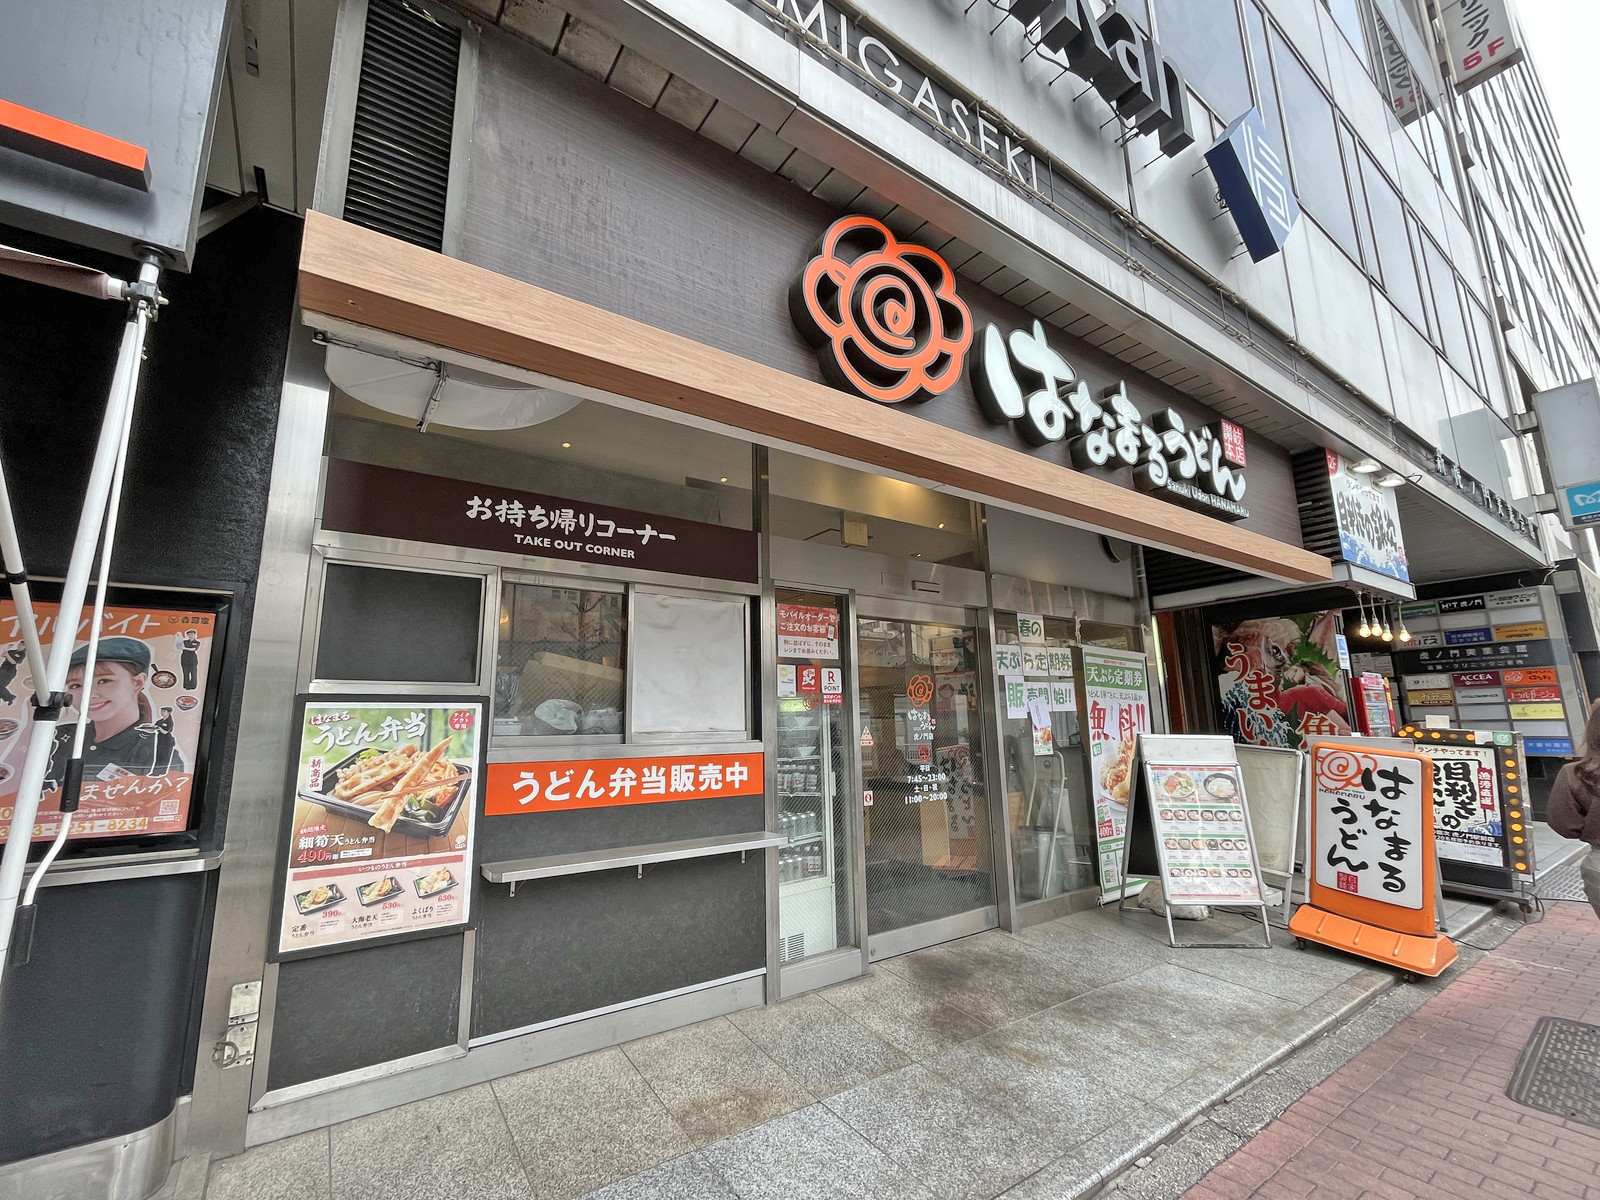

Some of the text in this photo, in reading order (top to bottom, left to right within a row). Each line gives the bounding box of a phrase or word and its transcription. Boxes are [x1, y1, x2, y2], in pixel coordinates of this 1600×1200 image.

[983, 318, 1247, 502] はなまるうどん
[1167, 478, 1249, 518] Sanuki Udon HANAMARU
[465, 495, 676, 545] お持ち帰りコーナー
[514, 533, 635, 559] TAKE OUT CORNER
[780, 622, 827, 634] ご注文のお客様
[1019, 619, 1042, 637] 春の
[1420, 644, 1528, 660] 虎ノ門実業会館
[1087, 666, 1143, 687] 天ぷら定期券
[1460, 673, 1493, 681] ACCEA
[1226, 643, 1277, 741] うまい
[310, 711, 351, 725] はなまる
[312, 712, 427, 753] うどん弁当
[1418, 746, 1487, 757] ランチやってます!
[309, 759, 322, 788] 新商品
[920, 764, 930, 772] 平日
[512, 762, 749, 806] うどん弁当販売中
[1319, 787, 1366, 800] HANAMARU
[1327, 797, 1369, 873] うどん
[1361, 766, 1414, 893] はなまる
[358, 862, 407, 872] いつものうどん弁当
[291, 923, 307, 933] 定番
